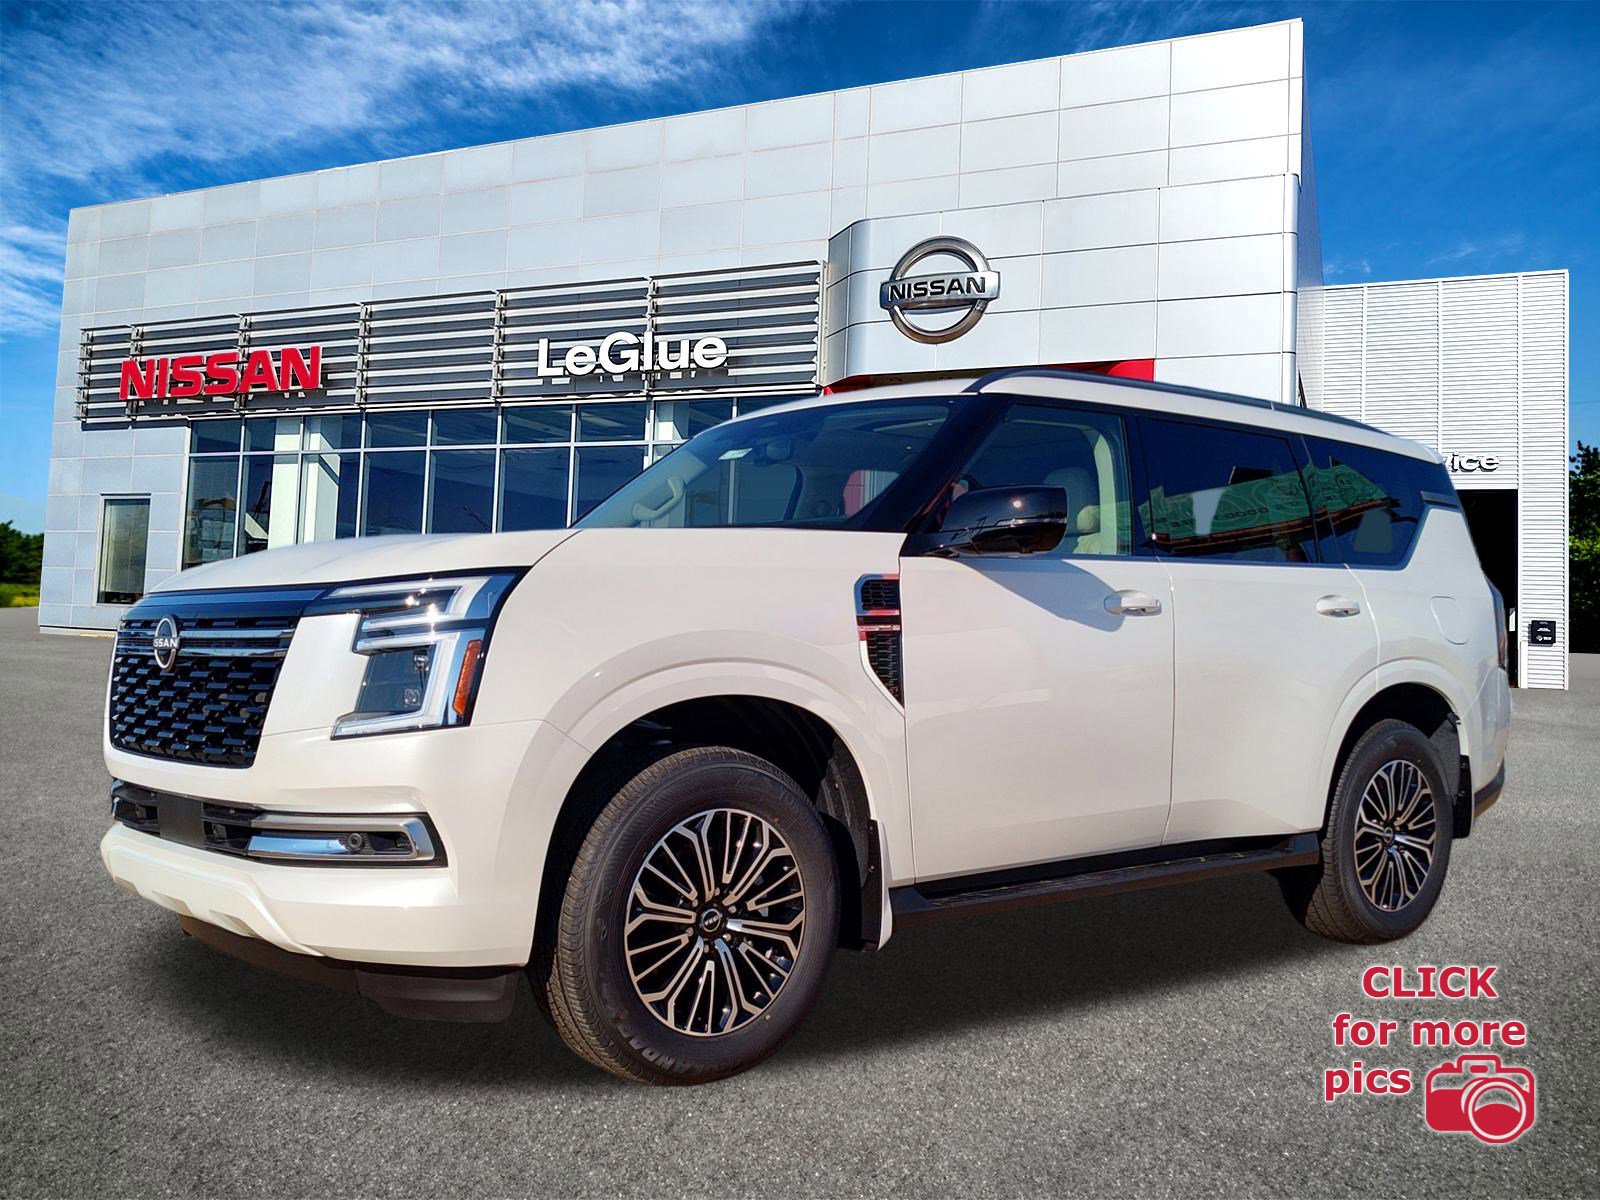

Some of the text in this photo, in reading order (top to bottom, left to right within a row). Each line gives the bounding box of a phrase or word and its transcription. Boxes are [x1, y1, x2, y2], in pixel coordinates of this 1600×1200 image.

[889, 277, 986, 300] NISSAN
[119, 346, 323, 401] NISSAN
[537, 331, 729, 377] LeGlue
